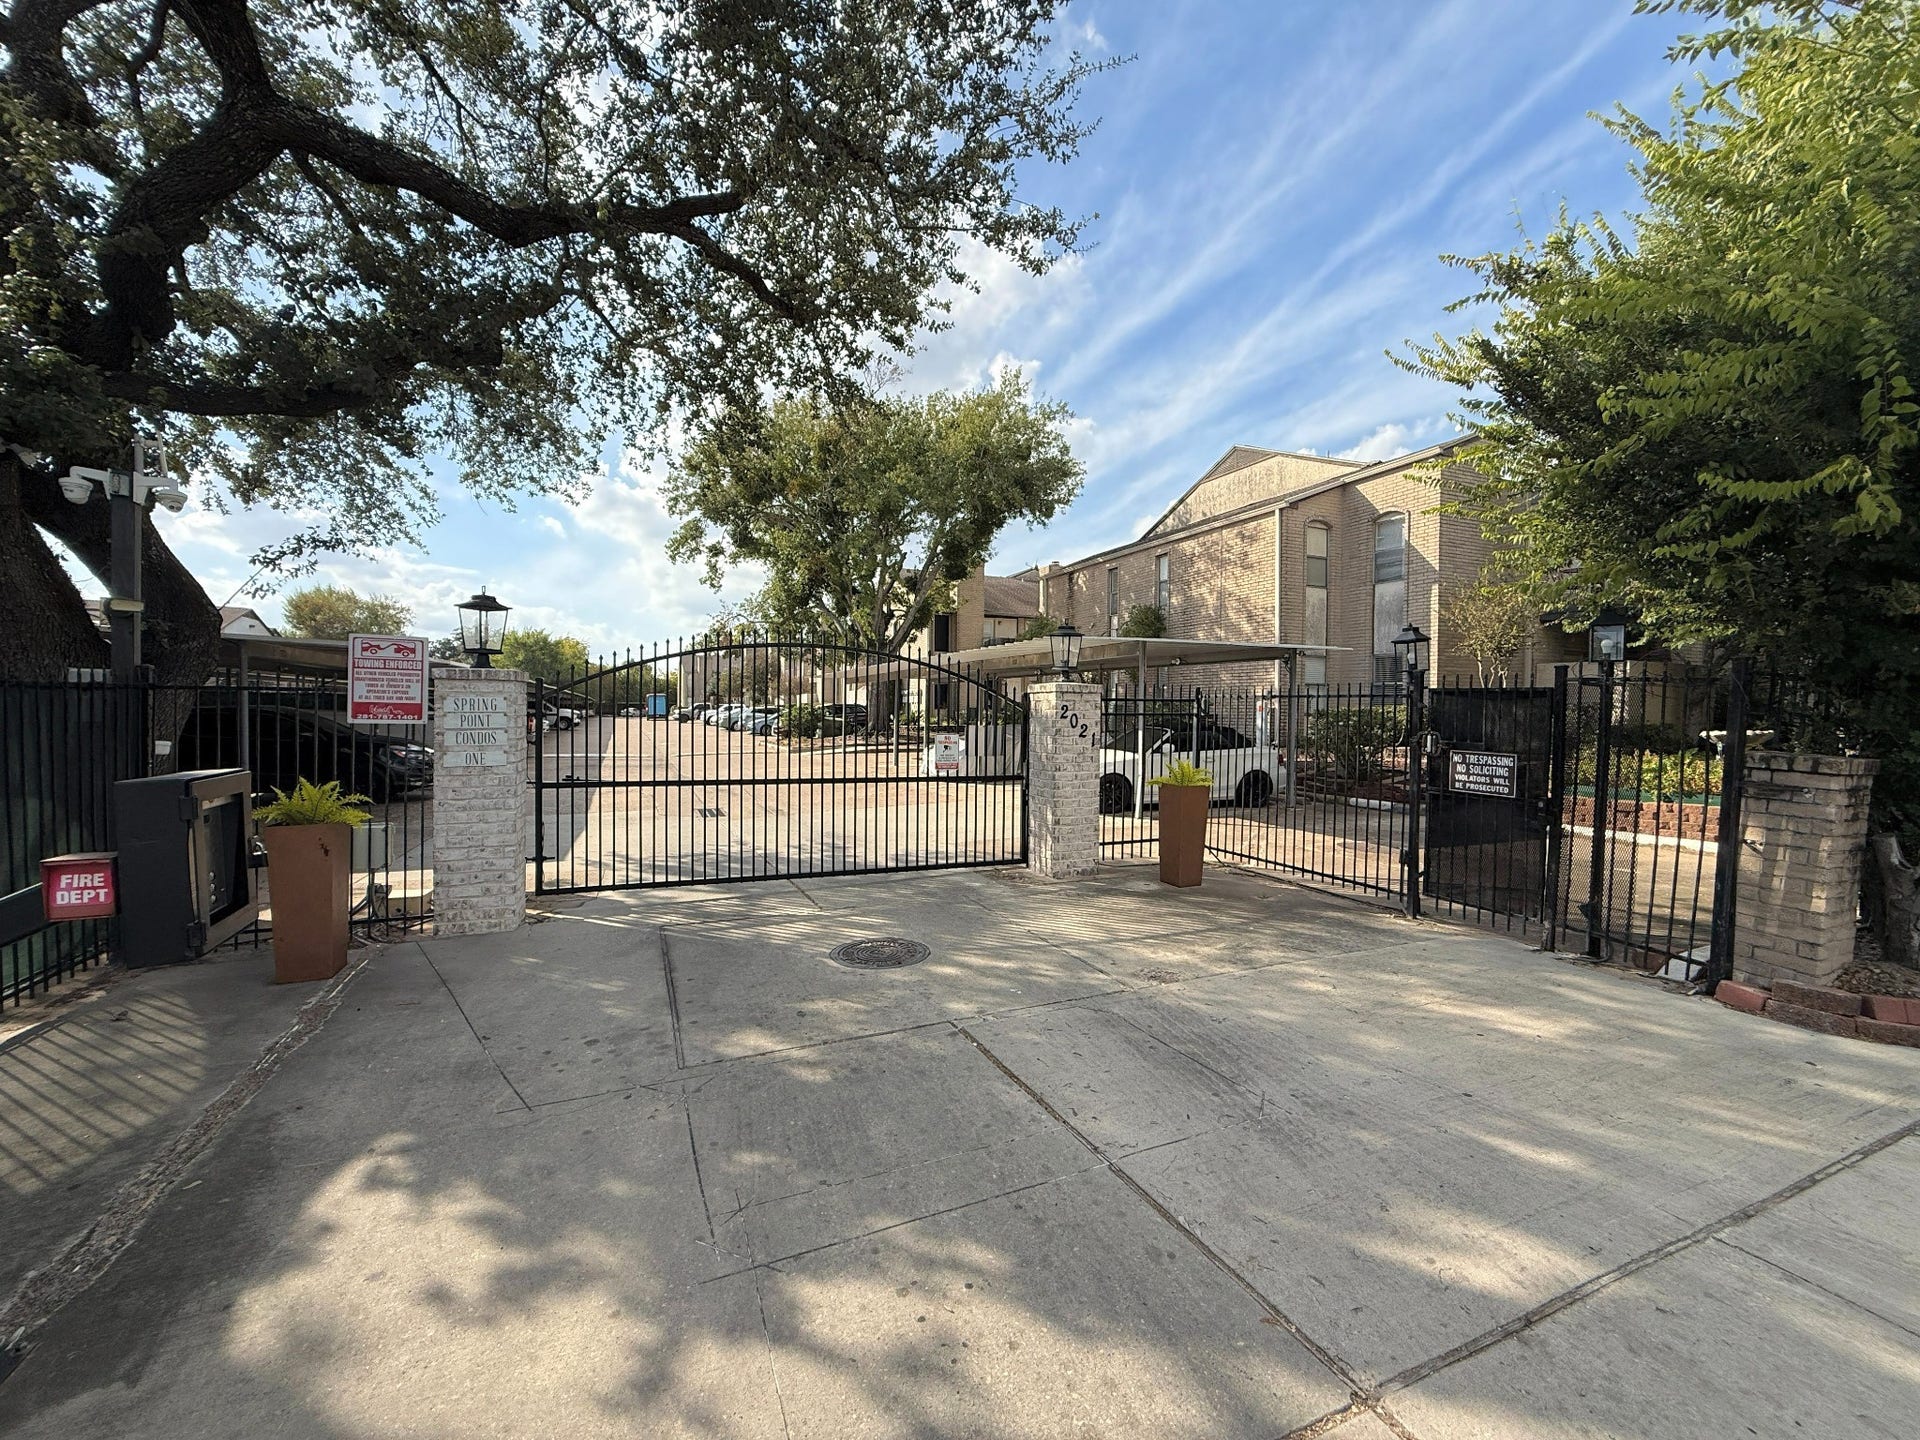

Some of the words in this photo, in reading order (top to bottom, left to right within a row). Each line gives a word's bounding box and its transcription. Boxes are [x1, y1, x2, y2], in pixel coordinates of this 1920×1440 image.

[354, 659, 384, 668] TOWING
[386, 660, 421, 669] ENFORCED
[454, 697, 497, 711] SPRING
[460, 714, 492, 728] POINT
[1060, 704, 1096, 748] 2021
[455, 731, 497, 745] CONDOS
[465, 752, 486, 766] ONE
[1452, 754, 1462, 763] NO
[1466, 754, 1514, 766] TRESPASSING
[1456, 764, 1466, 773] NO
[1469, 765, 1508, 776] SOLICITING
[1454, 774, 1490, 784] VIOLATORS
[1493, 778, 1510, 786] WILL
[1466, 782, 1508, 793] PROSECUTED
[60, 873, 104, 888] FIRE
[56, 888, 108, 904] DEPT
